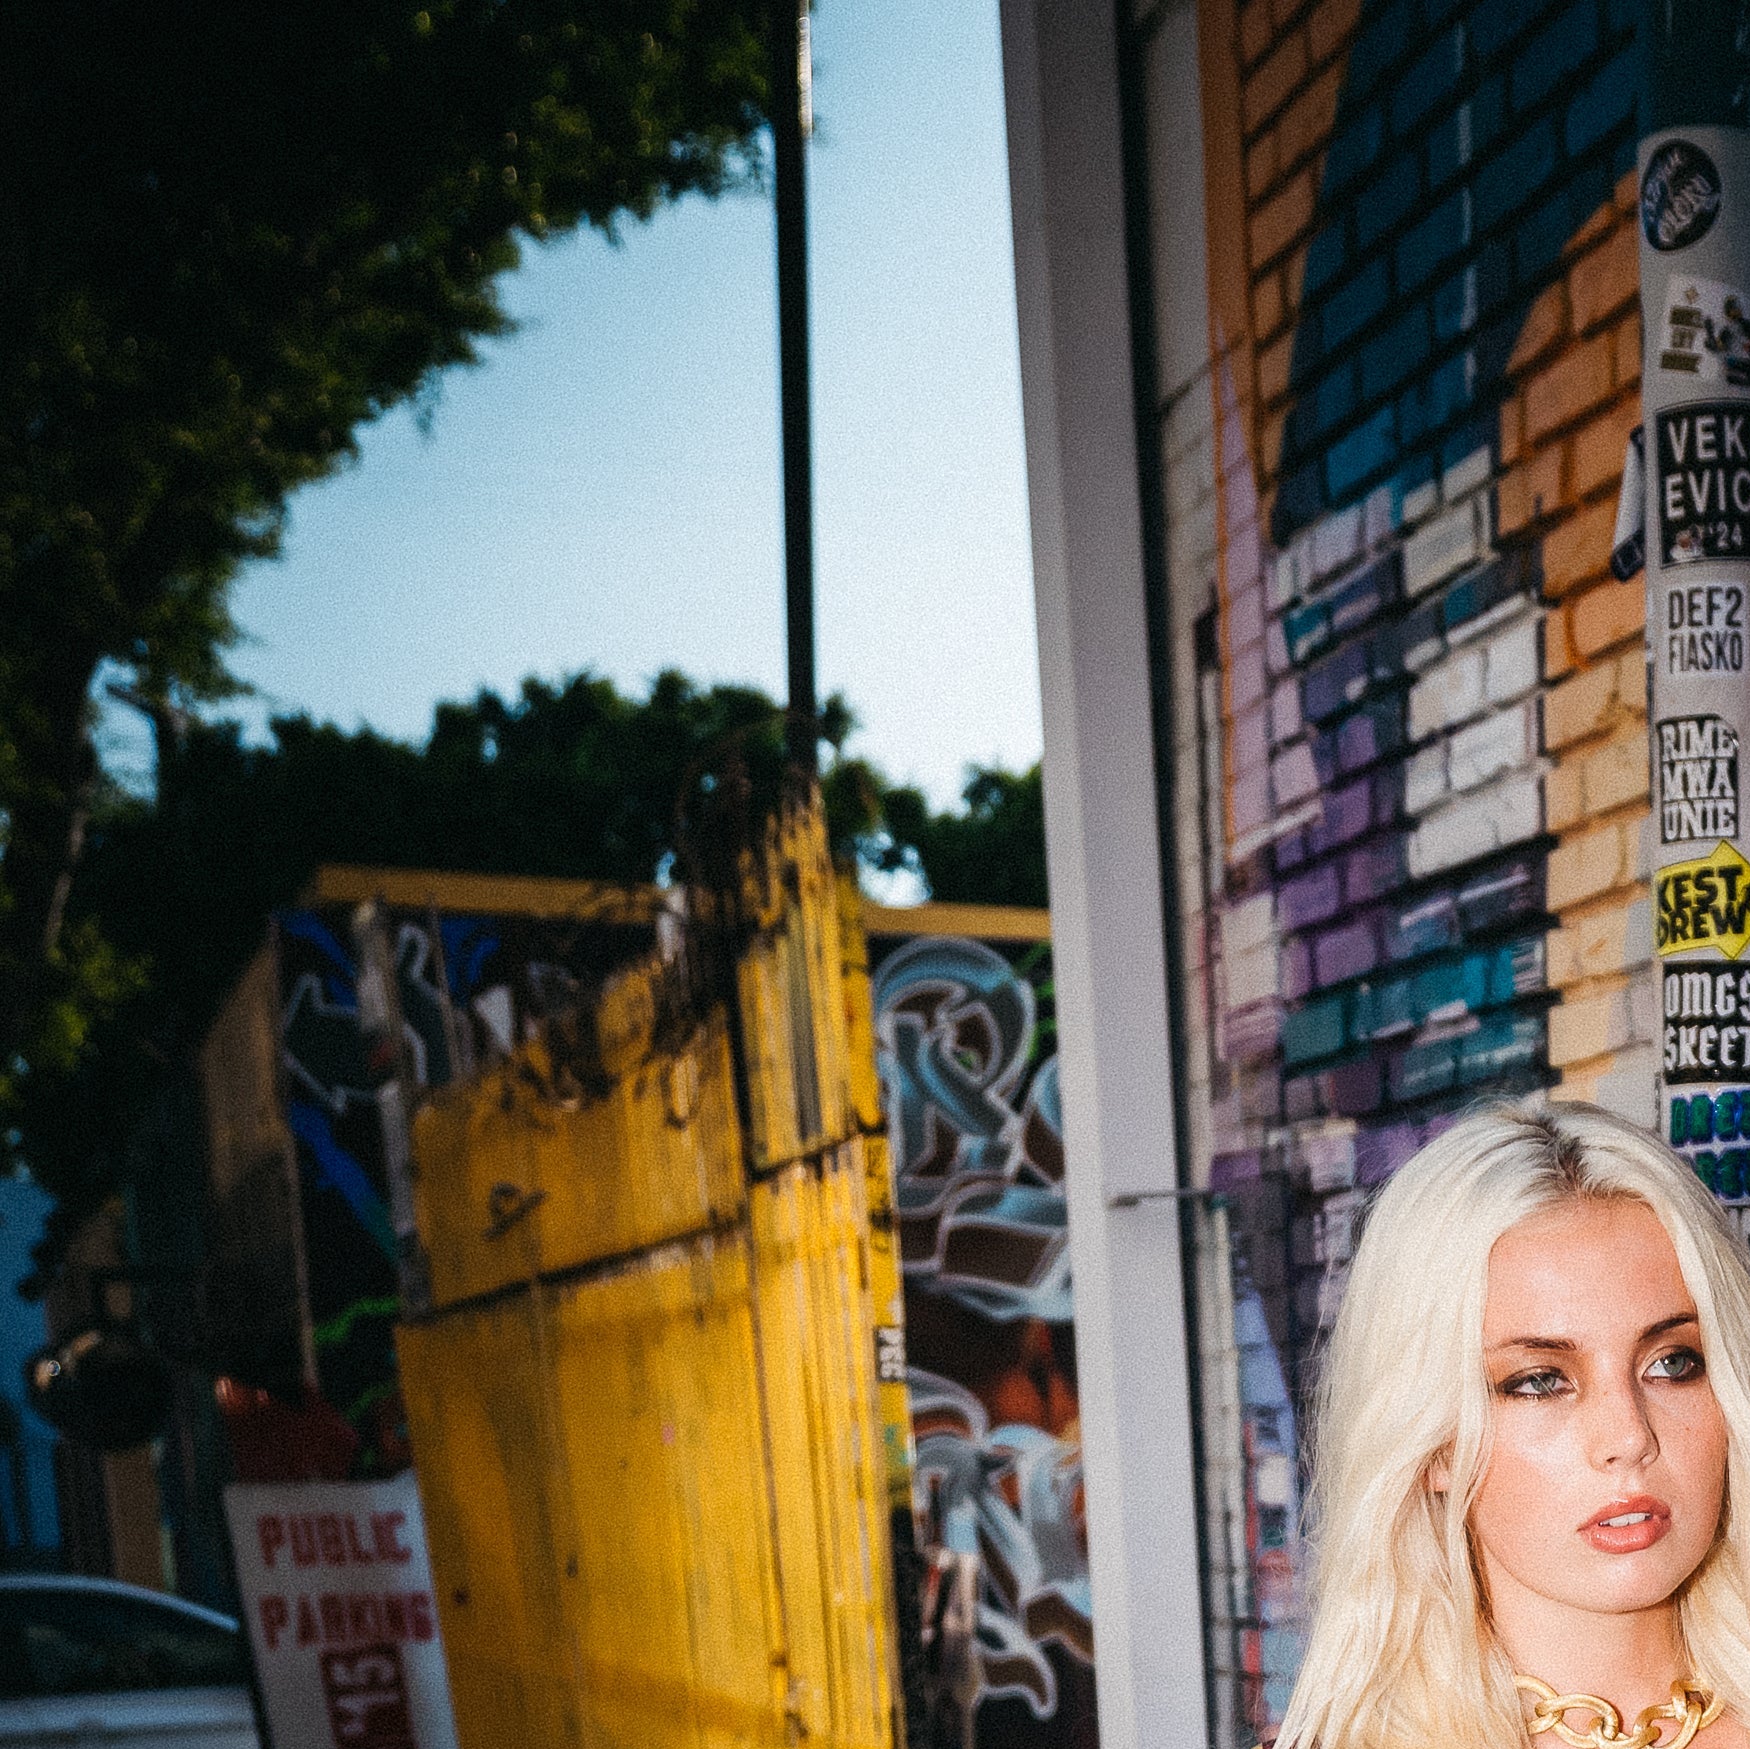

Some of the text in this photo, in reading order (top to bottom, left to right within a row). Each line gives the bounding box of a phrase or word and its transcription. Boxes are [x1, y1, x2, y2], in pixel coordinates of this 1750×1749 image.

[1668, 585, 1743, 630] DEF2
[1668, 631, 1743, 674] FIASKO
[1661, 720, 1735, 762] RIME
[257, 1511, 411, 1568] PUBLIC
[259, 1592, 433, 1651] PARKING
